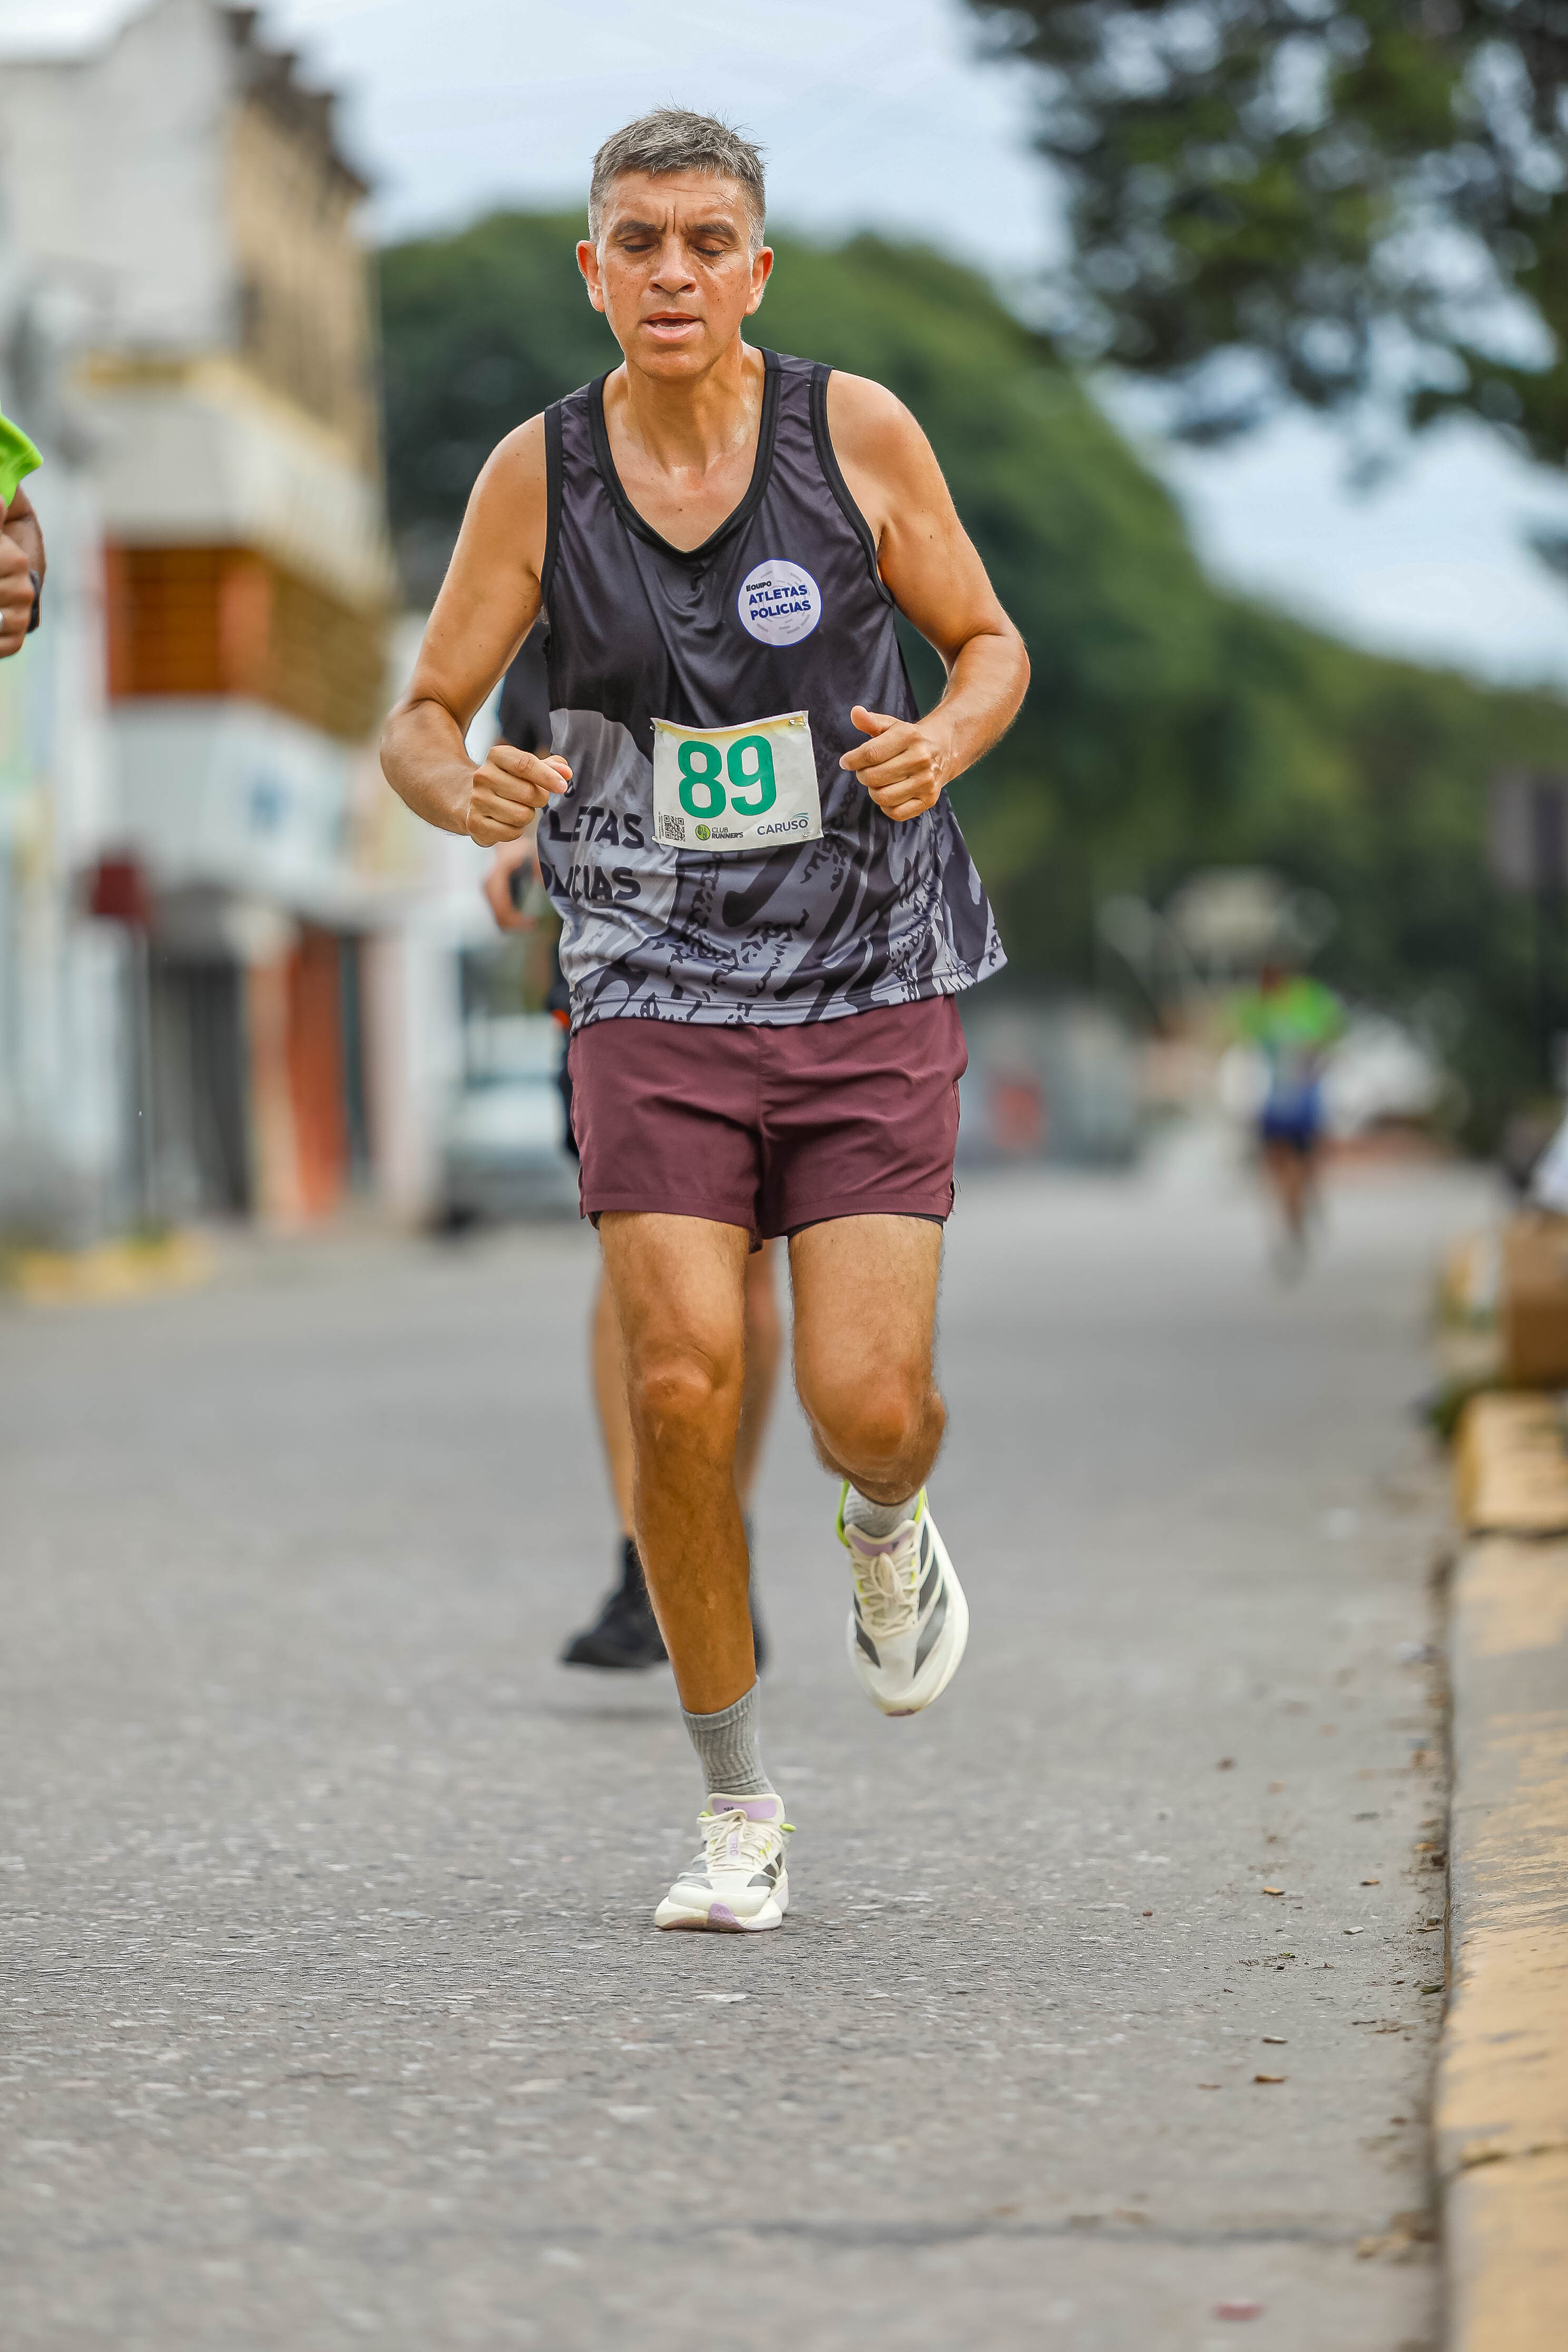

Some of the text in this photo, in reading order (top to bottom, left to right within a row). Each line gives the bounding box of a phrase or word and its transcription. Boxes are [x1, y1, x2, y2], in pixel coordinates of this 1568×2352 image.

[746, 581, 772, 592] EQUIPO
[749, 585, 808, 605] ATLETAS
[750, 600, 811, 620] POLICIAS
[678, 735, 777, 818] 89
[543, 805, 644, 849] LETAS
[757, 819, 808, 835] CARUSO
